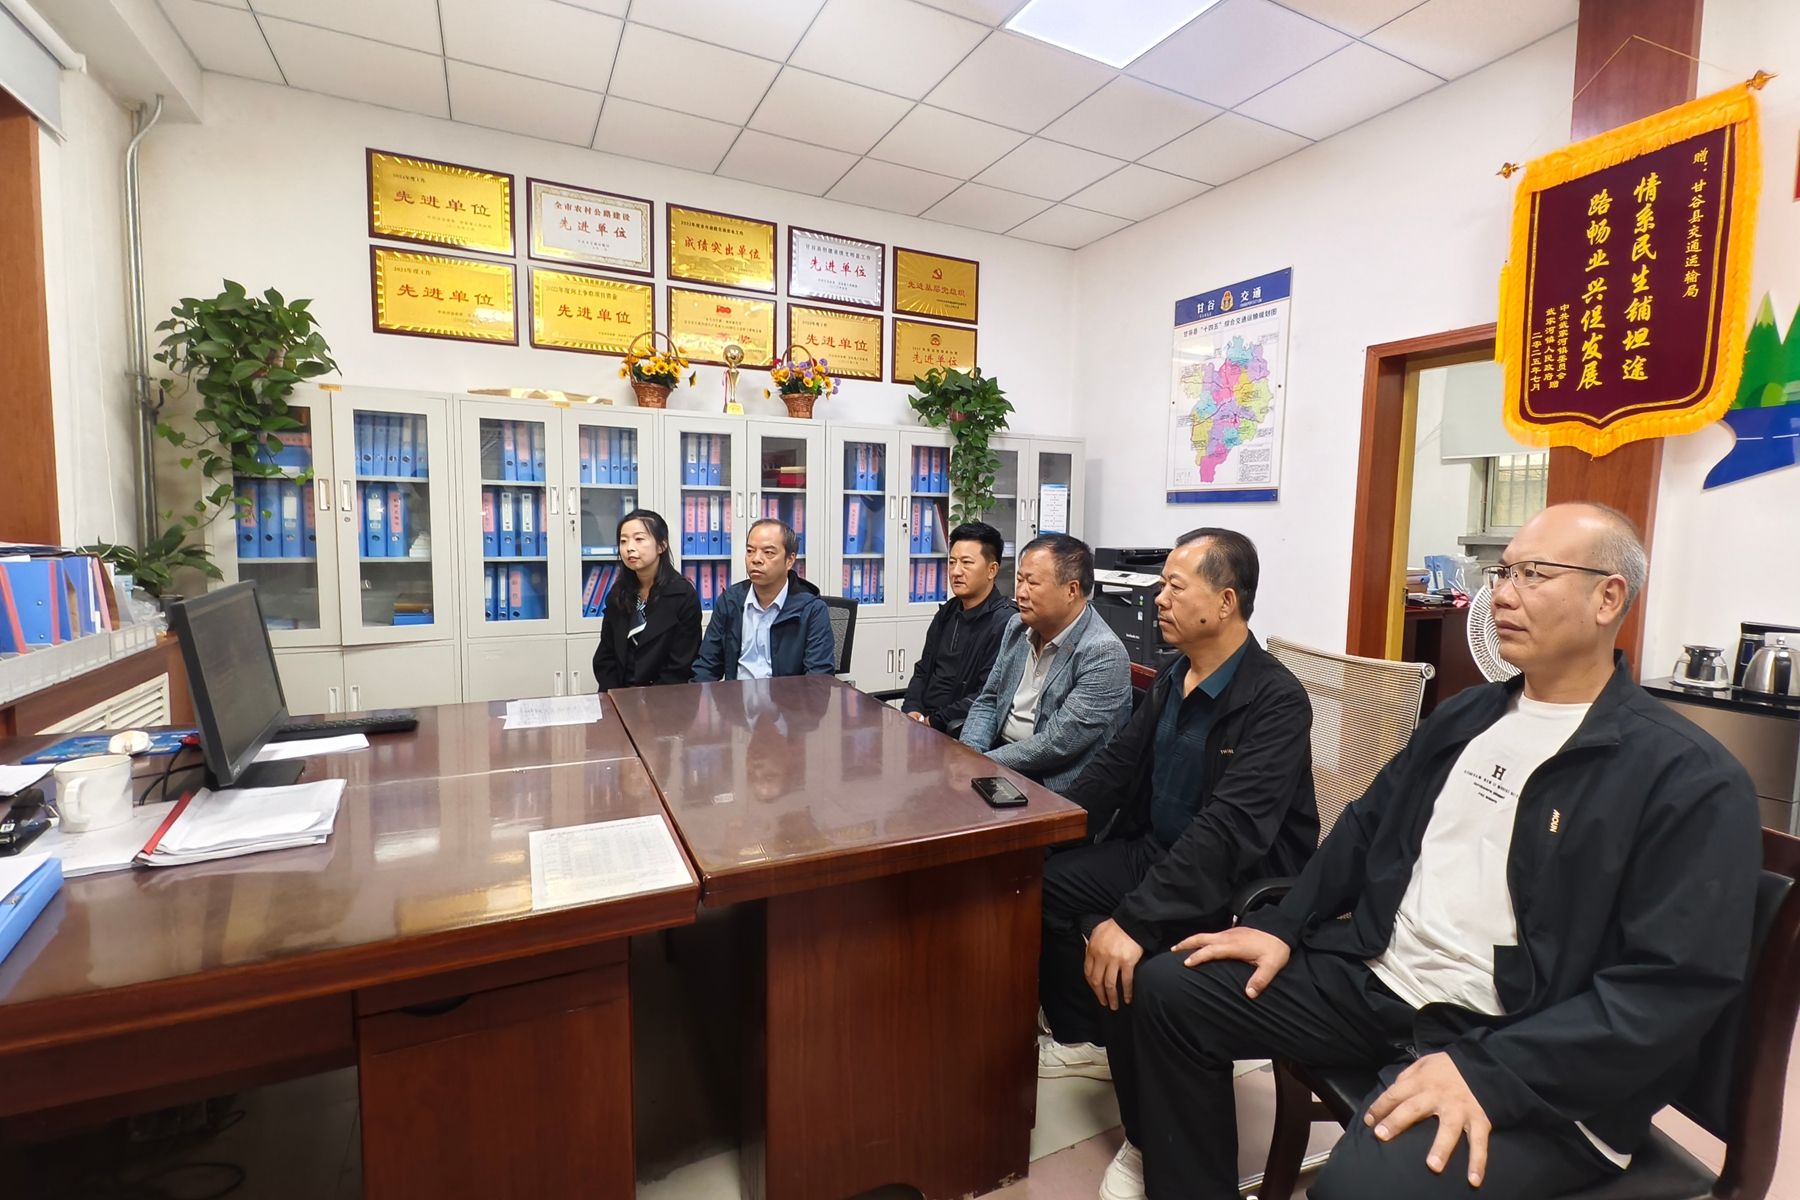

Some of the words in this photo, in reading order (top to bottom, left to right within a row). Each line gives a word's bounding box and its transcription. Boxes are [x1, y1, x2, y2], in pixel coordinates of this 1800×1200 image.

[394, 190, 491, 217] 先进单位
[554, 200, 631, 222] 全市农村公路建设
[559, 216, 628, 239] 先进单位
[684, 236, 761, 260] 成绩突出单位
[810, 255, 867, 278] 先进单位
[1622, 172, 1662, 381] 情系民生铺坦途
[396, 284, 495, 307] 先进单位
[907, 280, 967, 298] 先进基层党组织
[1197, 299, 1216, 315] 甘谷
[1240, 286, 1263, 303] 交通
[1577, 188, 1613, 391] 路畅业兴促发展
[557, 303, 631, 325] 先进单位
[805, 334, 868, 352] 先进单位
[912, 351, 958, 367] 先进单位
[1491, 764, 1507, 781] H
